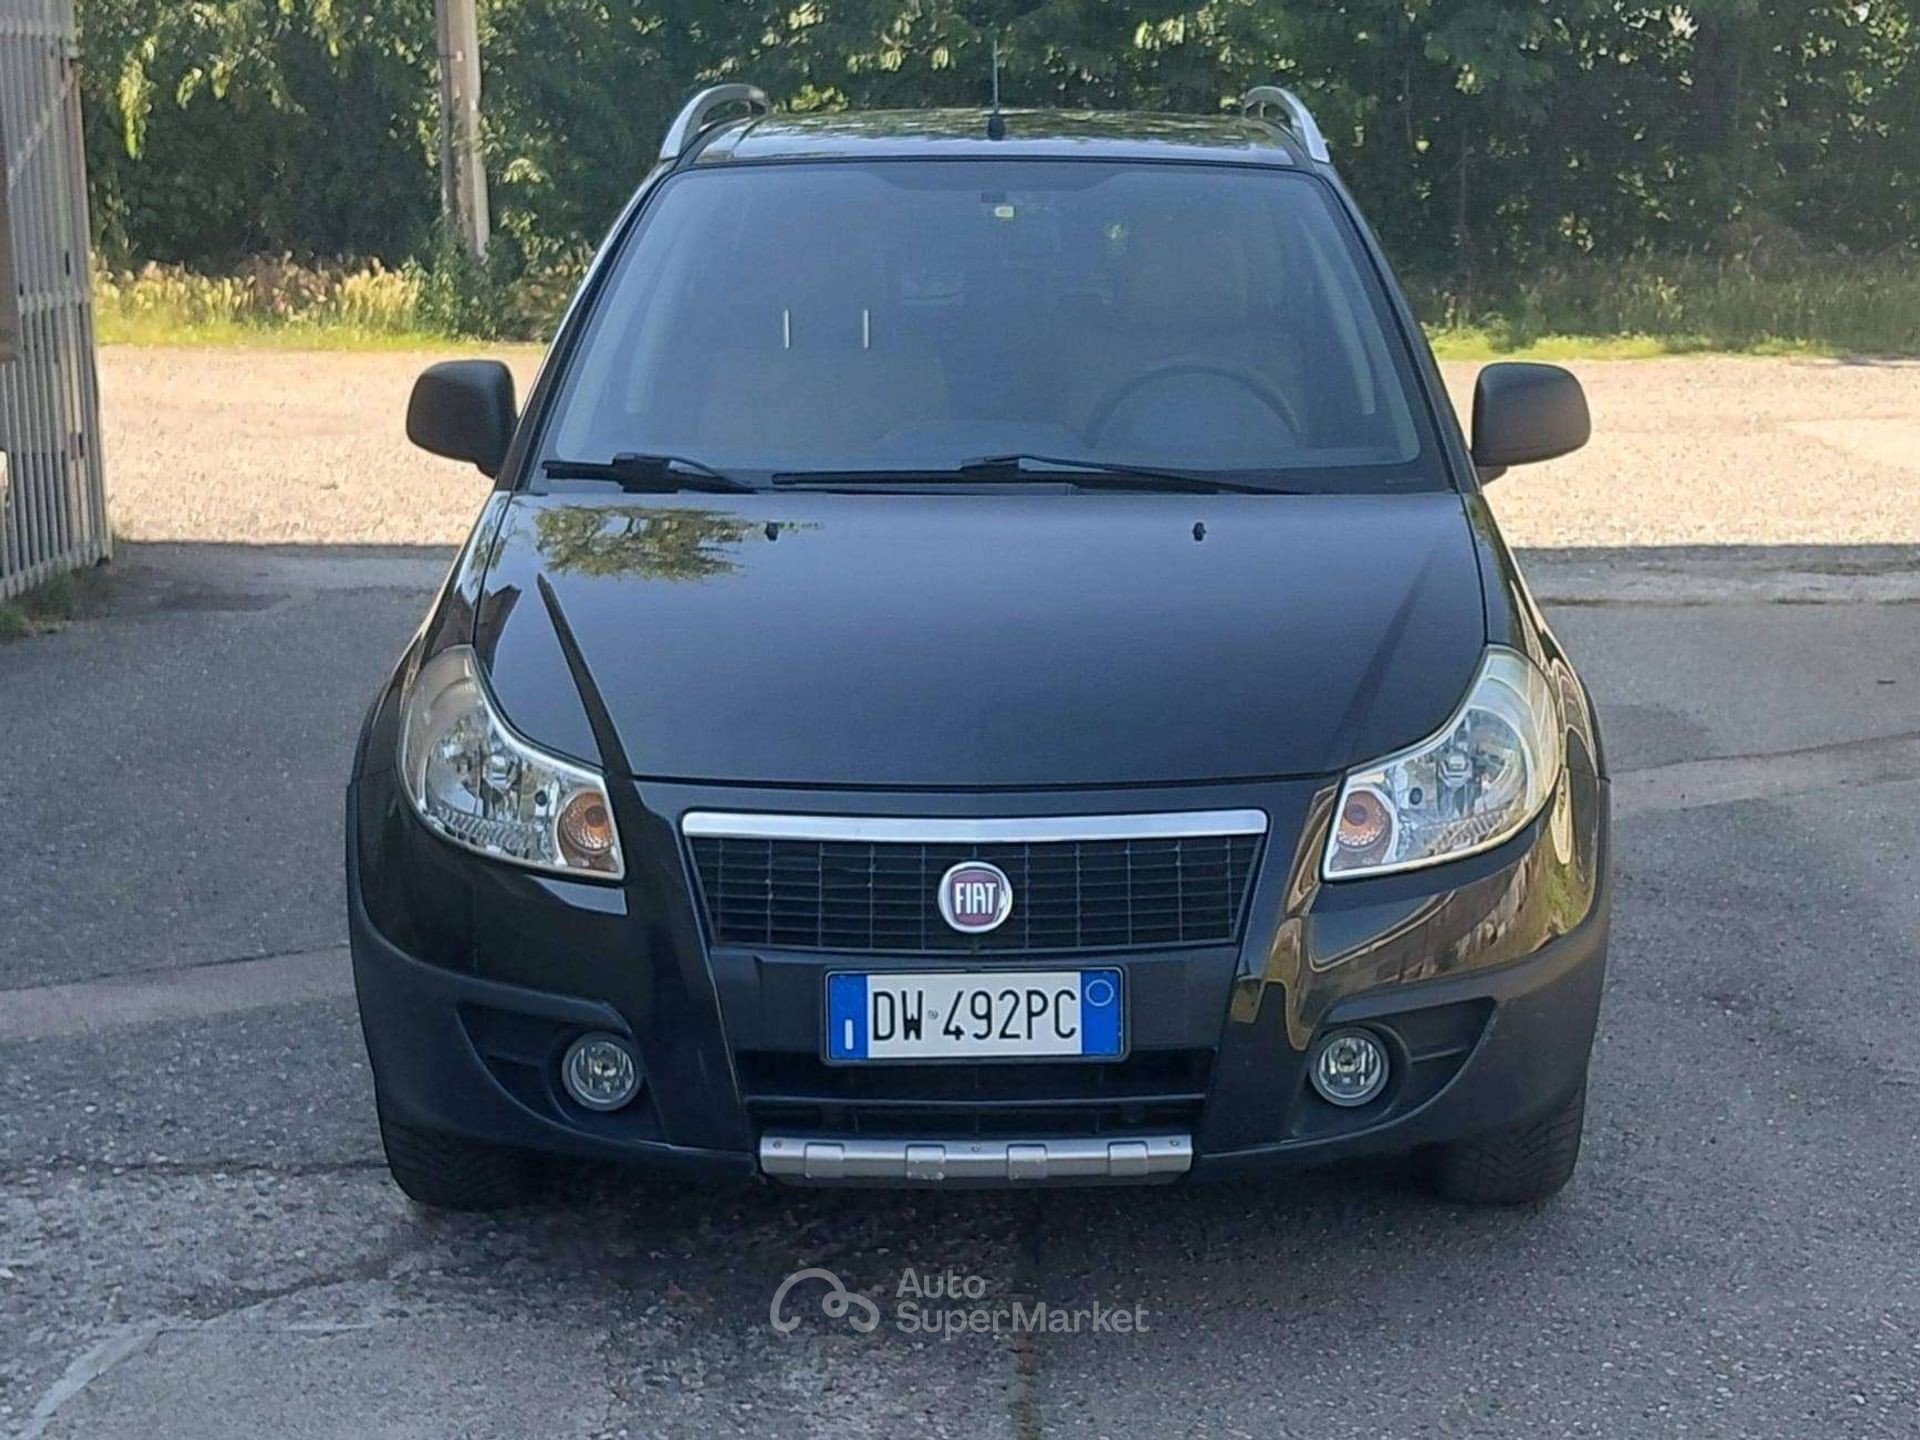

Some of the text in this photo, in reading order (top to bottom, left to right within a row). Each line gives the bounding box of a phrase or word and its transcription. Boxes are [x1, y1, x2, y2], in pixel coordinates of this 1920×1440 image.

[955, 882, 998, 915] FIAT
[872, 988, 1077, 1042] DW 492PC
[844, 1019, 854, 1050] I
